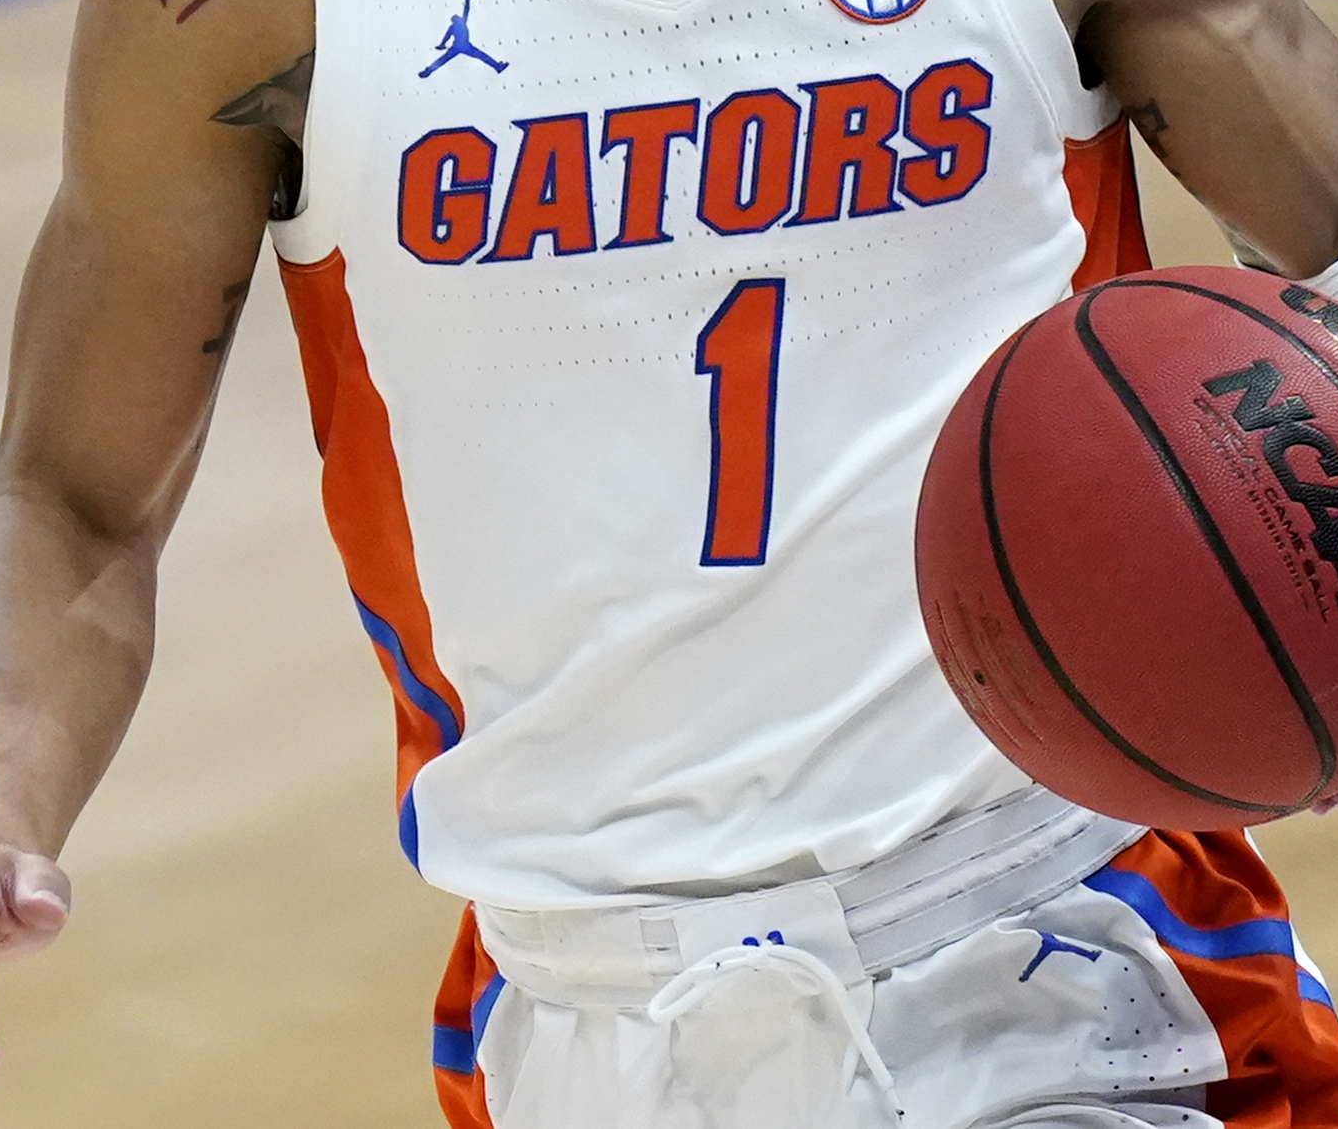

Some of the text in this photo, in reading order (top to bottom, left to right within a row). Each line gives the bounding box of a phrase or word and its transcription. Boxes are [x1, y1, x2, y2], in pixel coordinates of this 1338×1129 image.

[397, 57, 993, 266] GATORS
[695, 277, 786, 567] 1
[1262, 485, 1307, 555] GAME
[1300, 557, 1334, 622] BALL
